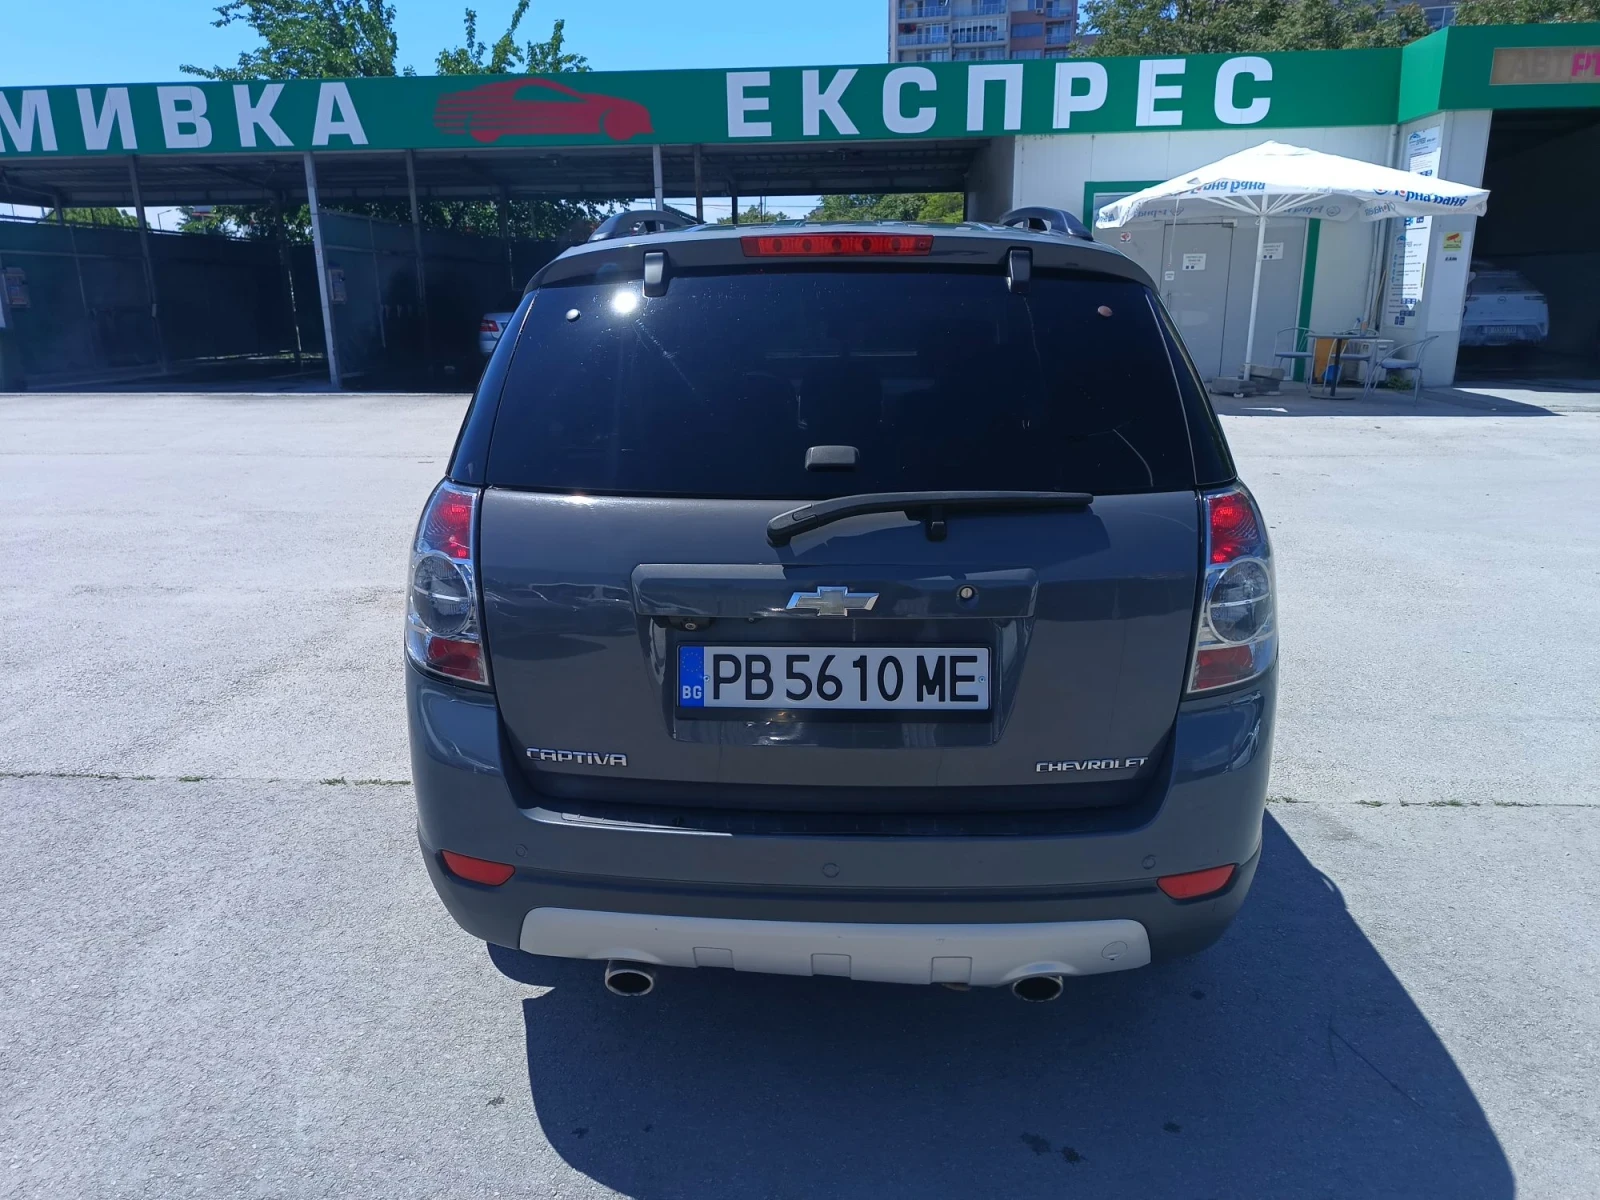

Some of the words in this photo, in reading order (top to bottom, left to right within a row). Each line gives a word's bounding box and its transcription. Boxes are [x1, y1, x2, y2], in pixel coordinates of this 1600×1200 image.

[0, 82, 369, 152] МИВКА
[726, 56, 1273, 138] ЕКСПРЕС
[713, 654, 774, 701] PB
[785, 654, 904, 702] 5610
[916, 655, 979, 702] ME
[682, 685, 702, 700] BG
[526, 747, 627, 767] CAPTIVA
[1036, 756, 1149, 773] CHEVROLET
